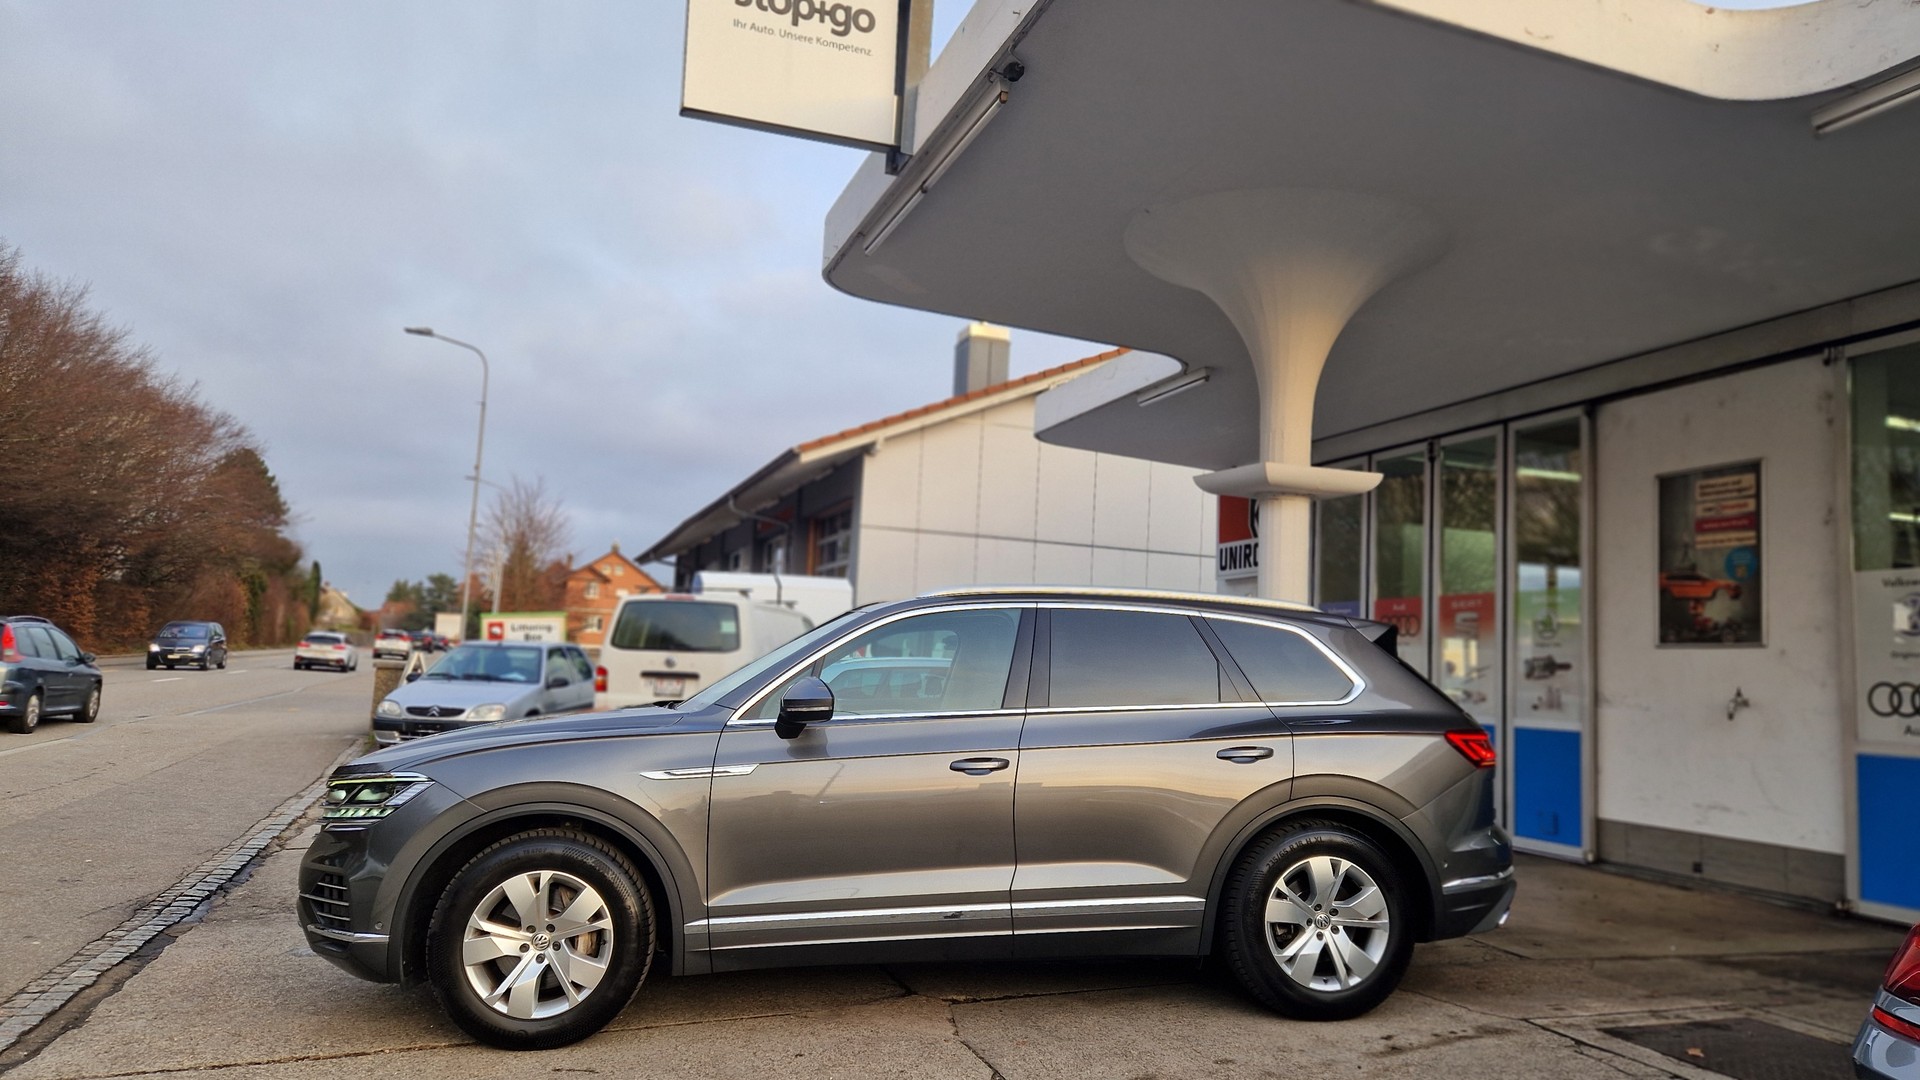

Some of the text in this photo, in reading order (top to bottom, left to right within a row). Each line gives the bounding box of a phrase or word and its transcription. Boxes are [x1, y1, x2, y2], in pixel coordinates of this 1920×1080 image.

[733, 18, 873, 56] Ihr Auto. Unsere Kompetenz.
[735, 0, 876, 37] op+go
